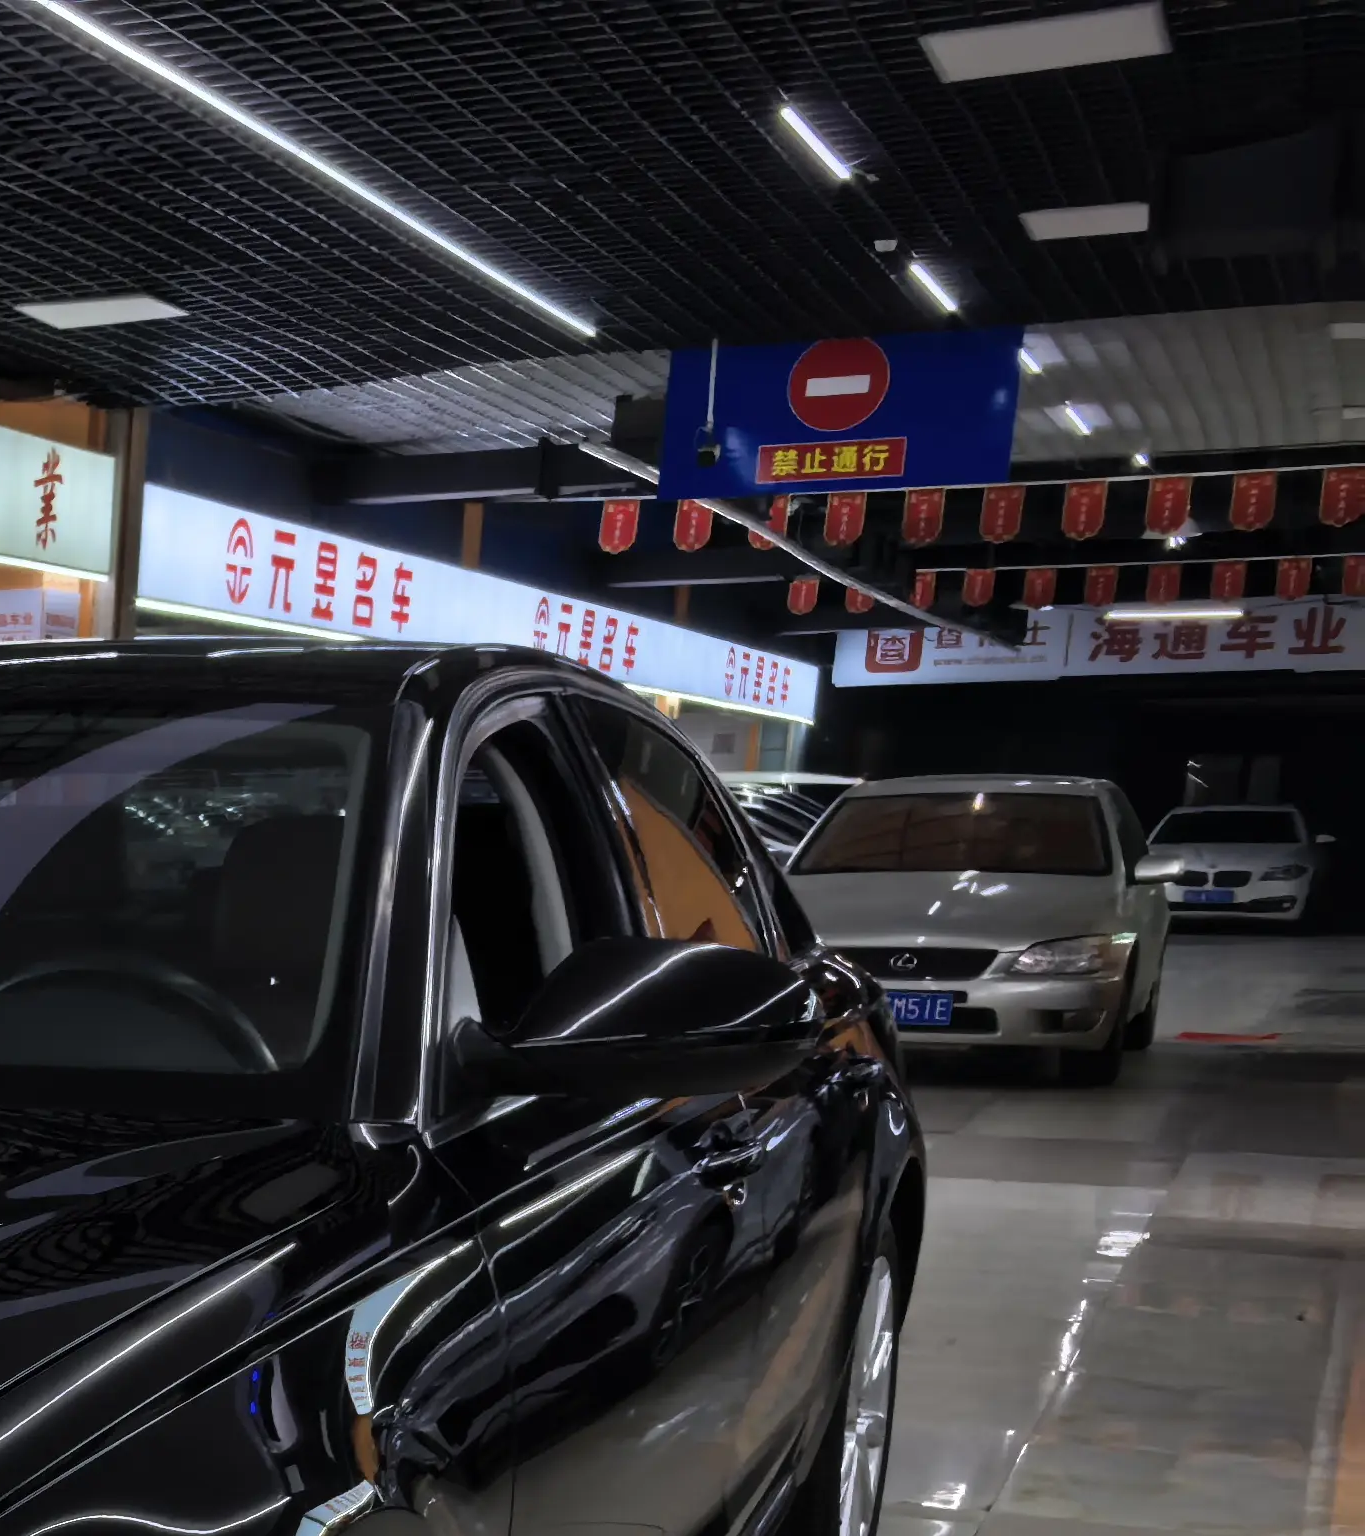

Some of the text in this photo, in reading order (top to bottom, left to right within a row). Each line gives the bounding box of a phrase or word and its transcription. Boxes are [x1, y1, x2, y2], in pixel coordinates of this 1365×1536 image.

[772, 444, 890, 477] 禁止通行
[1088, 605, 1347, 662] 海通车业
